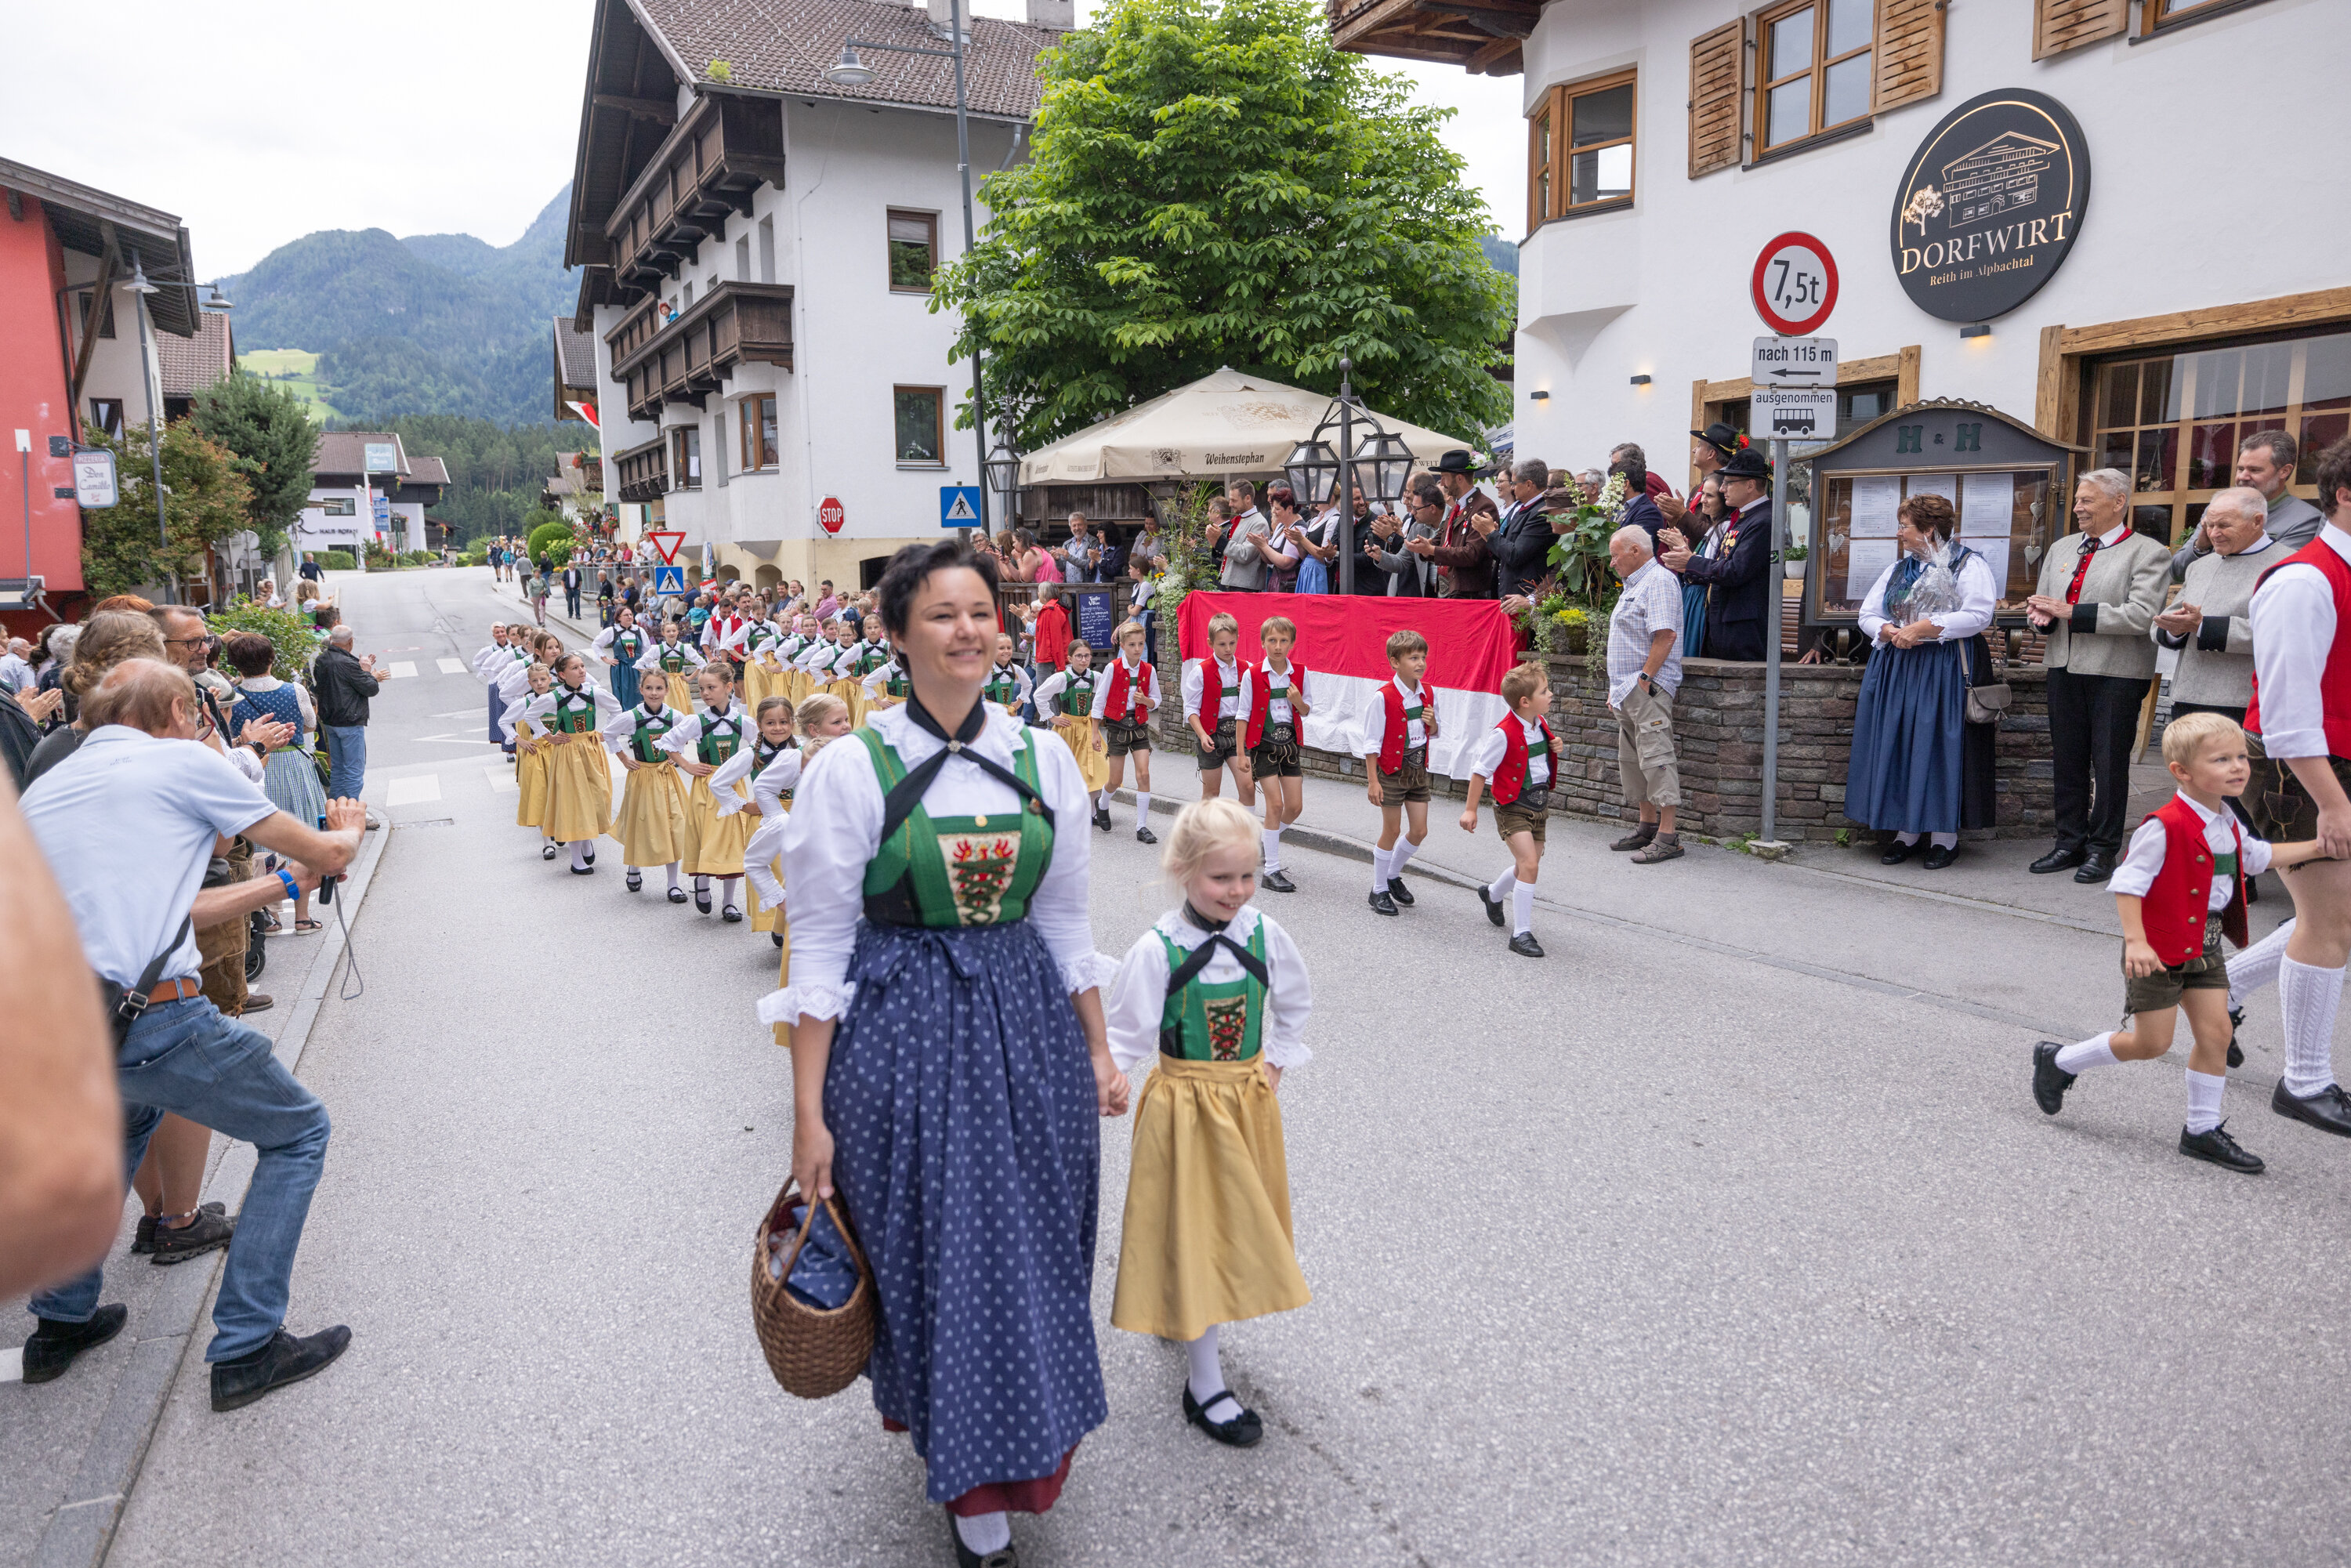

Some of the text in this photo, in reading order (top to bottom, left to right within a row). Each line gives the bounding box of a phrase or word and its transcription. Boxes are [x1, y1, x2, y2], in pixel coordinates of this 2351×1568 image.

[1900, 210, 2072, 274] DORFWIRT
[1930, 255, 2034, 286] Reith im Alpbachtal
[1759, 346, 1832, 361] nach 115 m
[1755, 394, 1832, 405] ausgenommen
[1896, 423, 1983, 453] H & H
[1205, 452, 1264, 465] Weihenstephan
[83, 466, 103, 478] Don
[80, 479, 110, 490] Camillo
[822, 508, 842, 523] STOP
